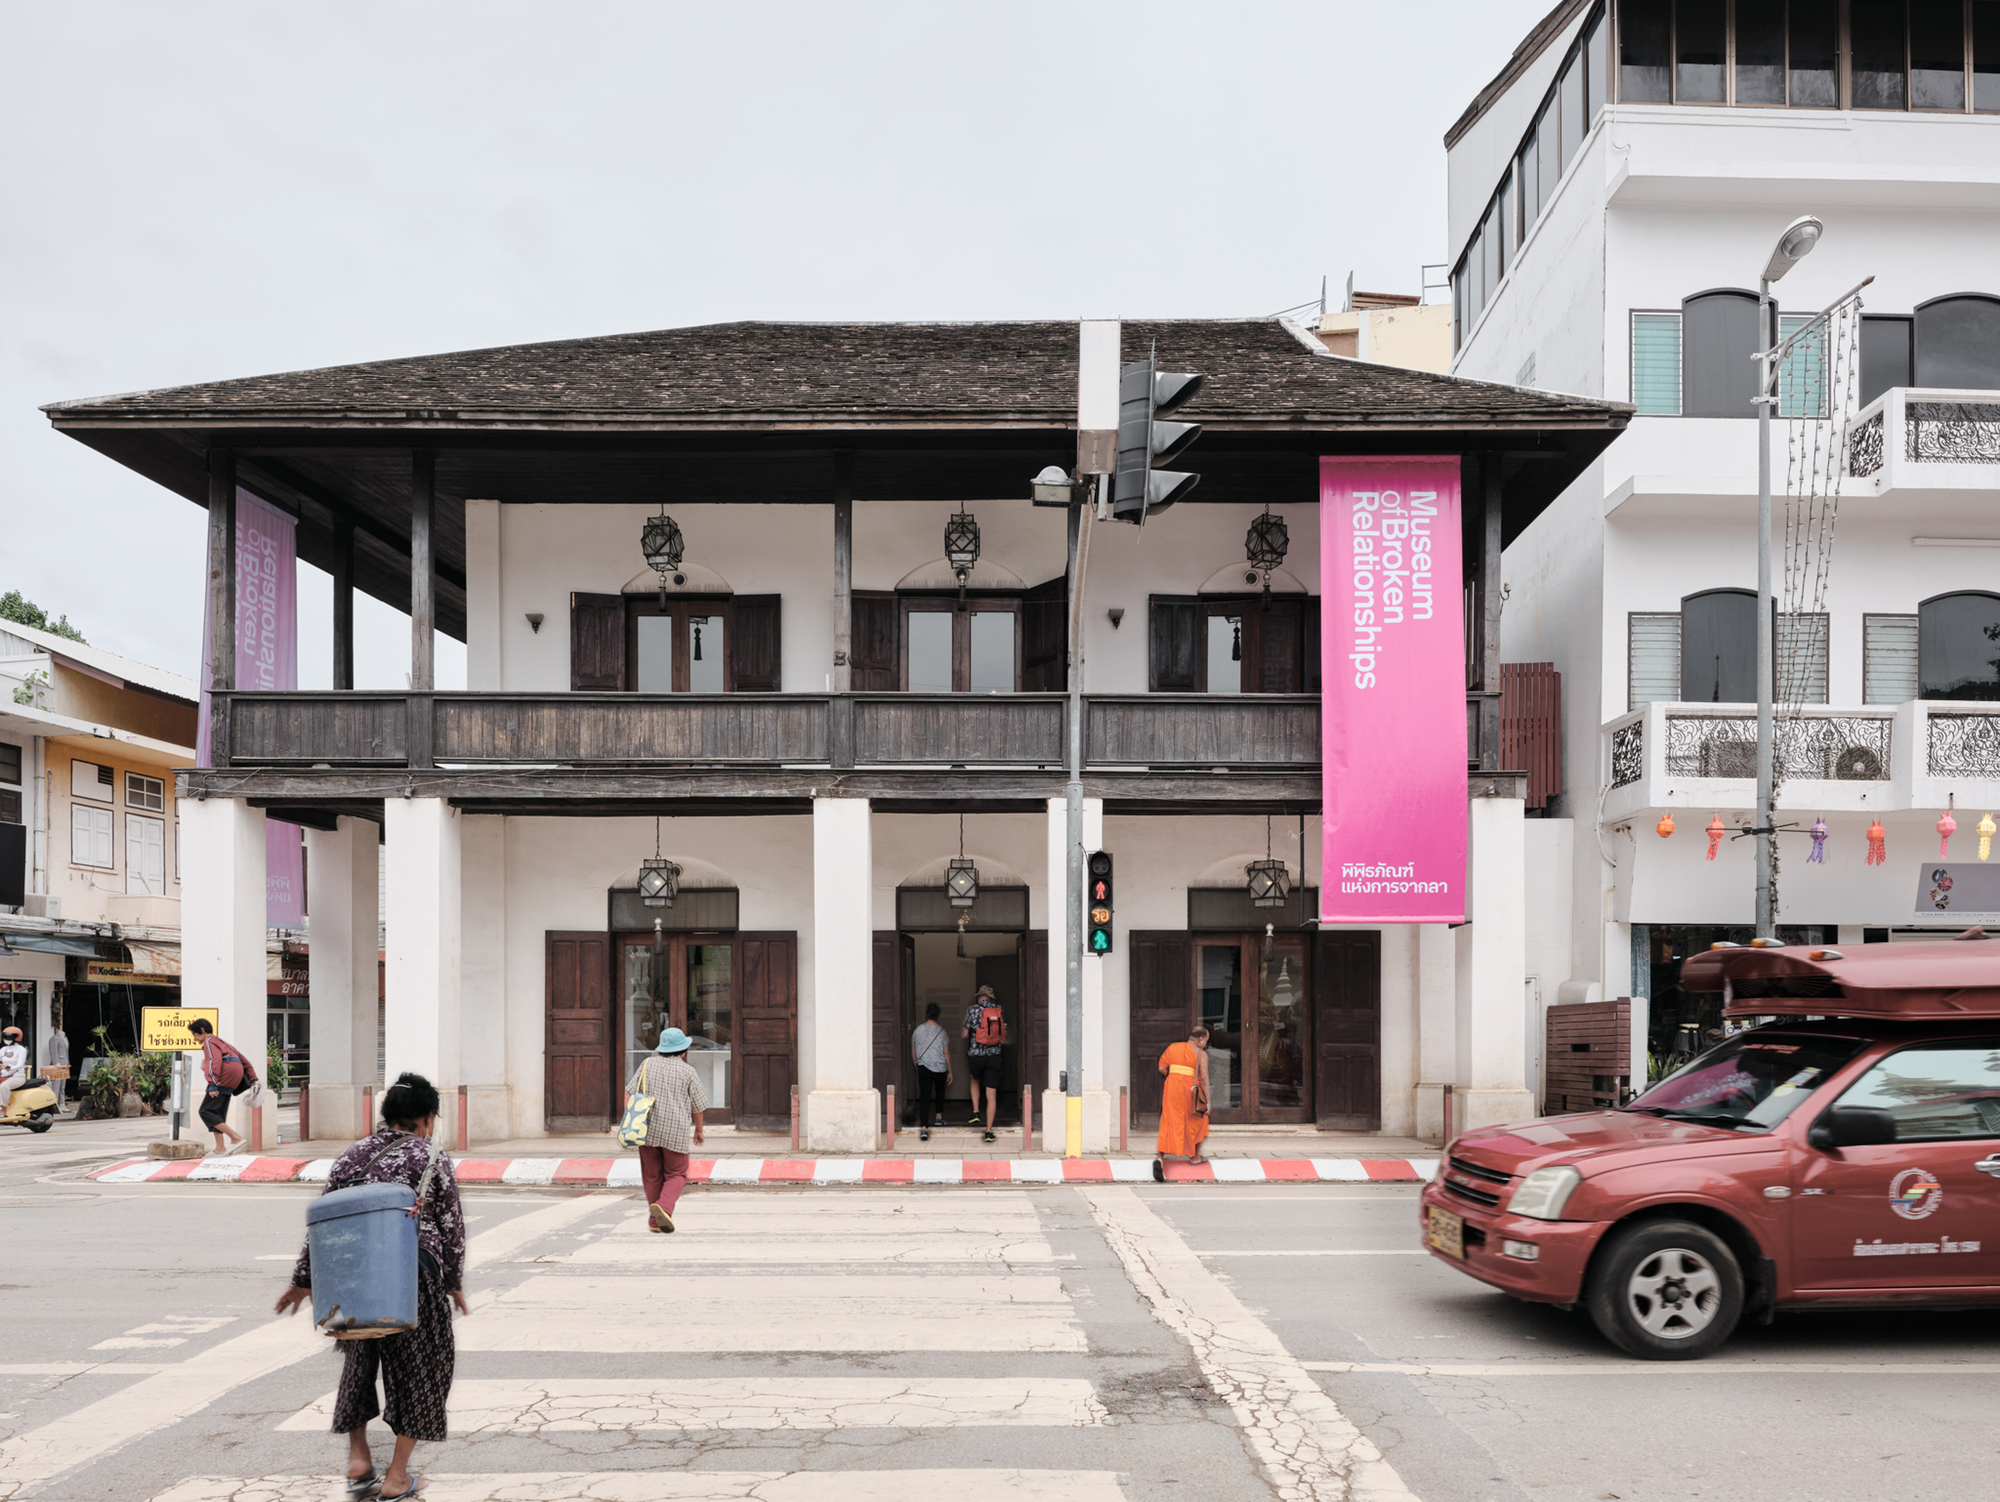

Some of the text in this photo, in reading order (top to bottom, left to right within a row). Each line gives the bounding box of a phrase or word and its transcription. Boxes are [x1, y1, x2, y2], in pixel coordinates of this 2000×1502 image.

[1410, 491, 1438, 619] Museum
[1381, 519, 1410, 623] Broken
[1349, 491, 1382, 689] Relationships
[1341, 861, 1414, 878] พิพิธภัณฑ์
[1341, 878, 1448, 893] แห่งการจากลา
[148, 950, 182, 976] Ko
[157, 1012, 196, 1028] รถเลี้ยว
[148, 1034, 204, 1046] ใช้ช่องทาง
